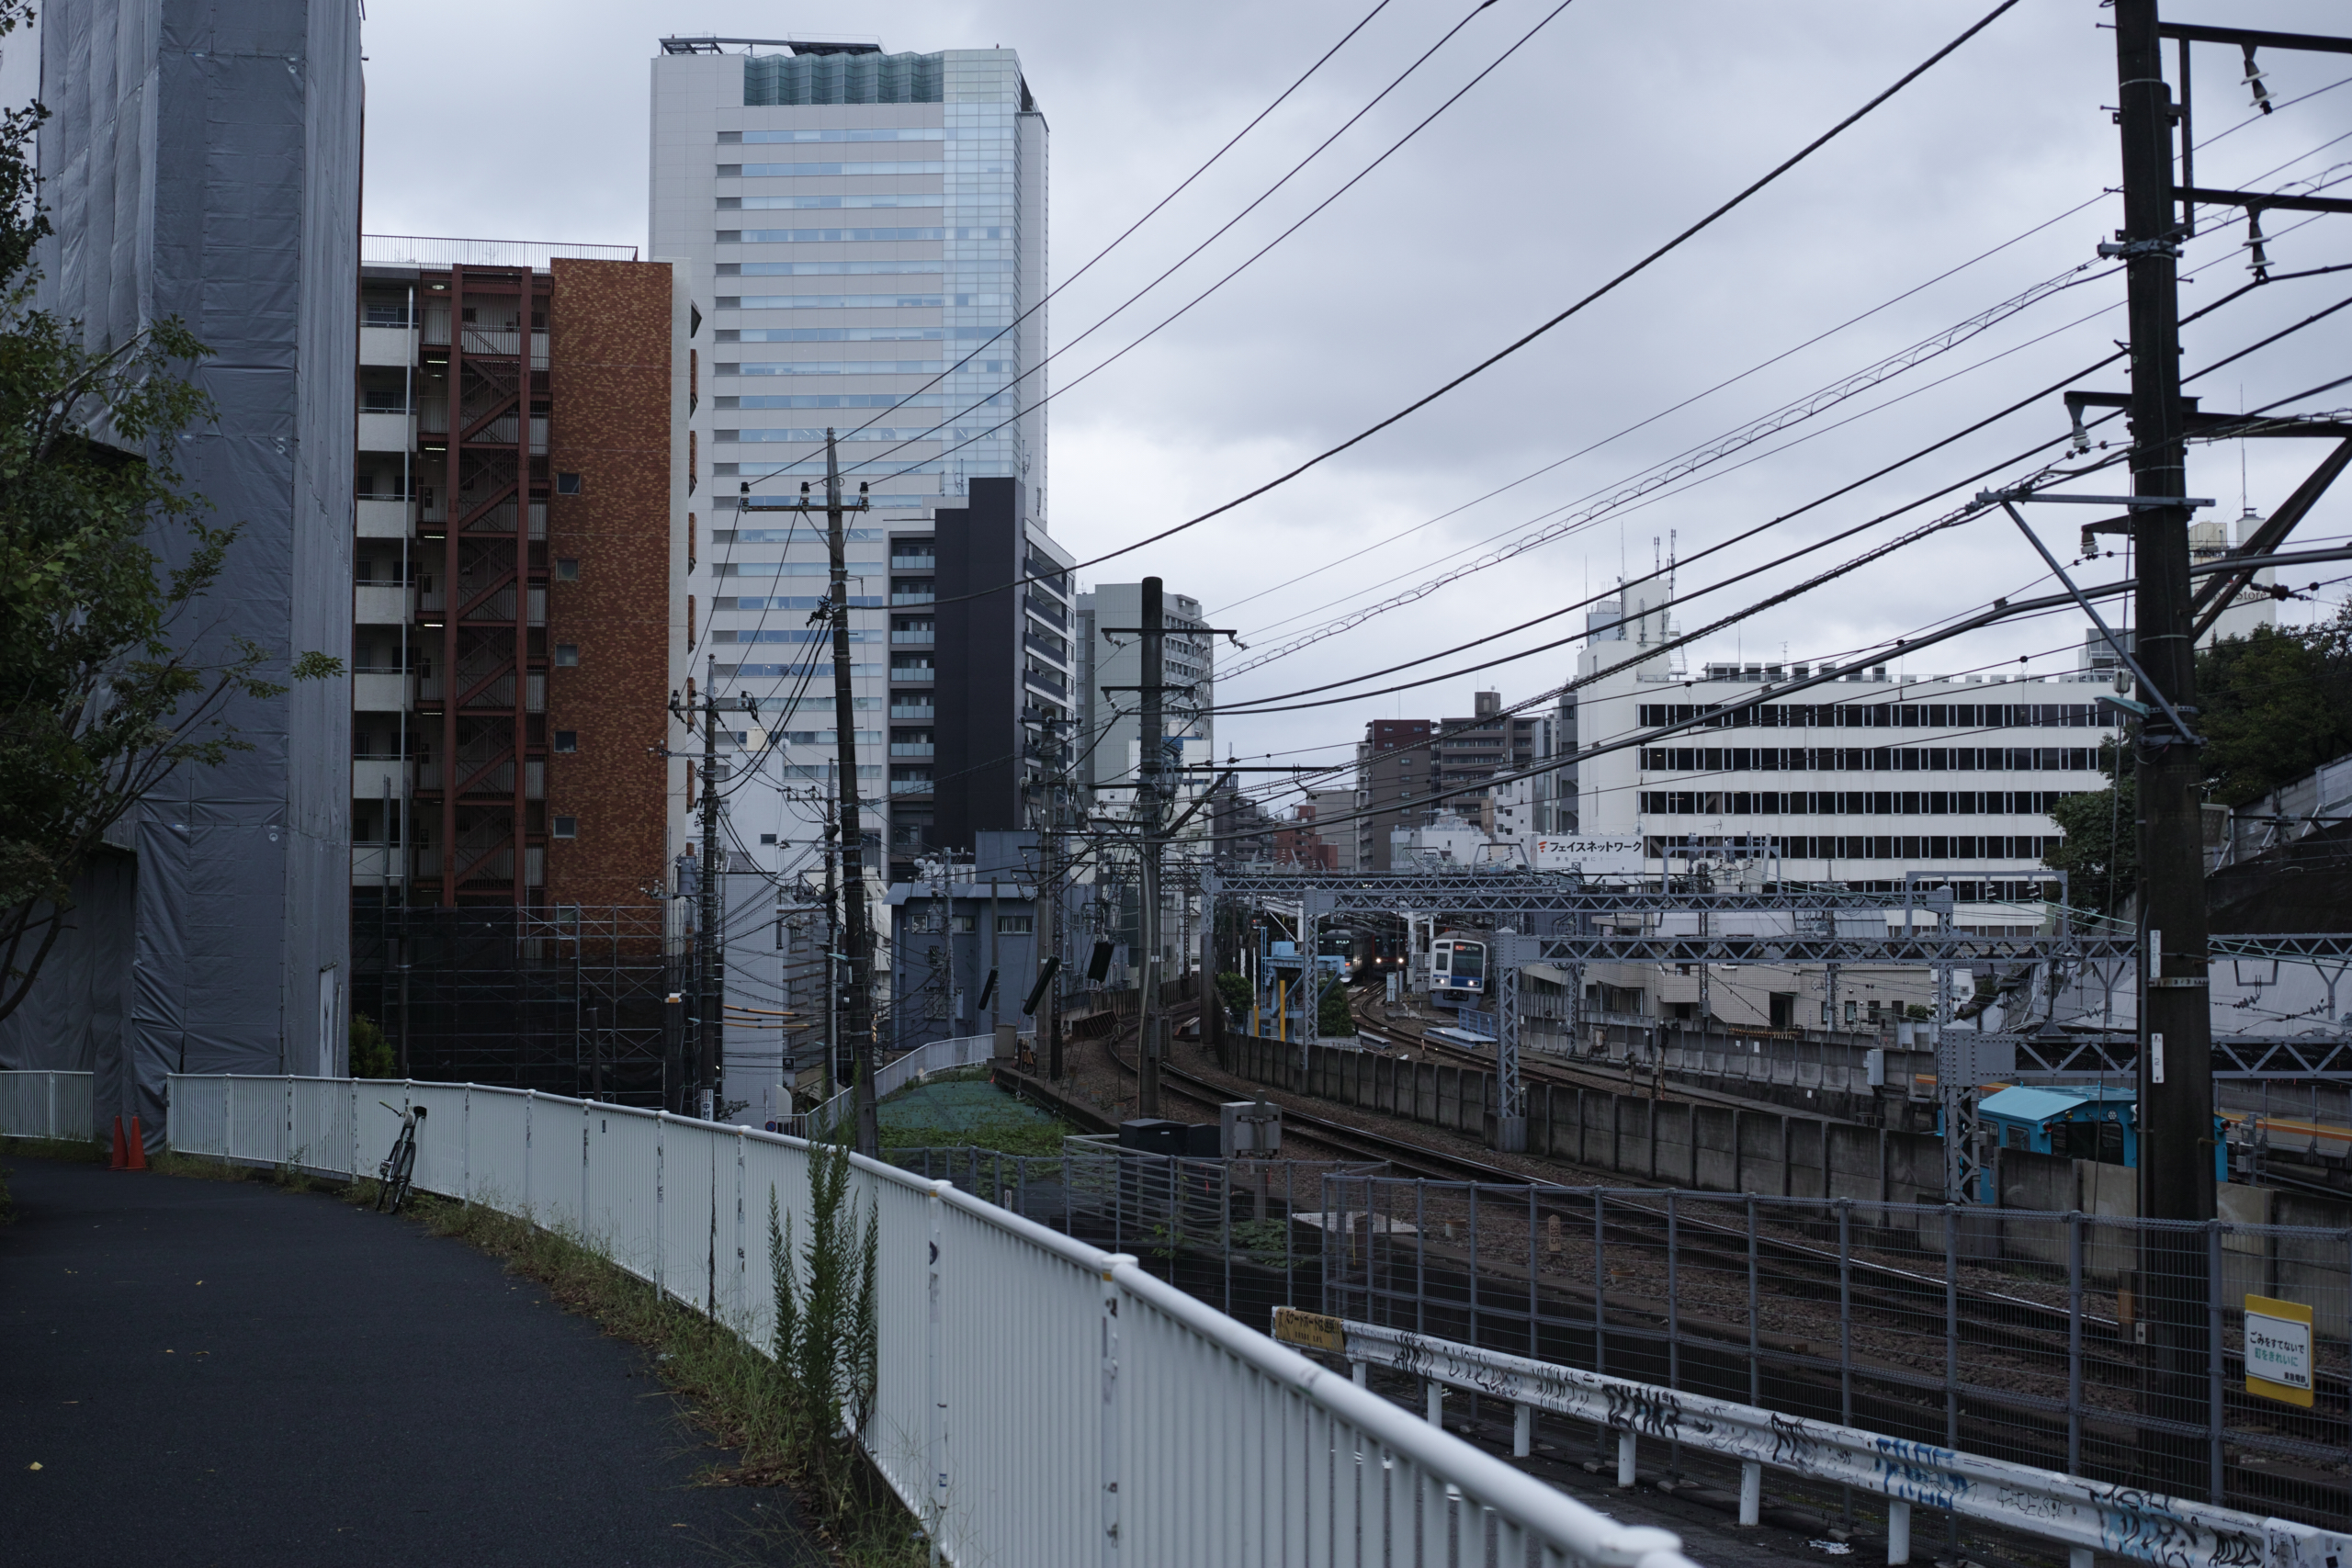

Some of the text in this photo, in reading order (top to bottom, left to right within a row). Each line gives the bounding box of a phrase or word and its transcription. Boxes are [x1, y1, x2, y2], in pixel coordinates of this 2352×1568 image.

[2235, 590, 2267, 600] Store
[1550, 840, 1643, 852] フェイスネットワーク
[2249, 1331, 2305, 1355] ごみをすてないで
[2255, 1348, 2299, 1367] 町をきれいに
[2284, 1371, 2306, 1383] 東急電鉄
